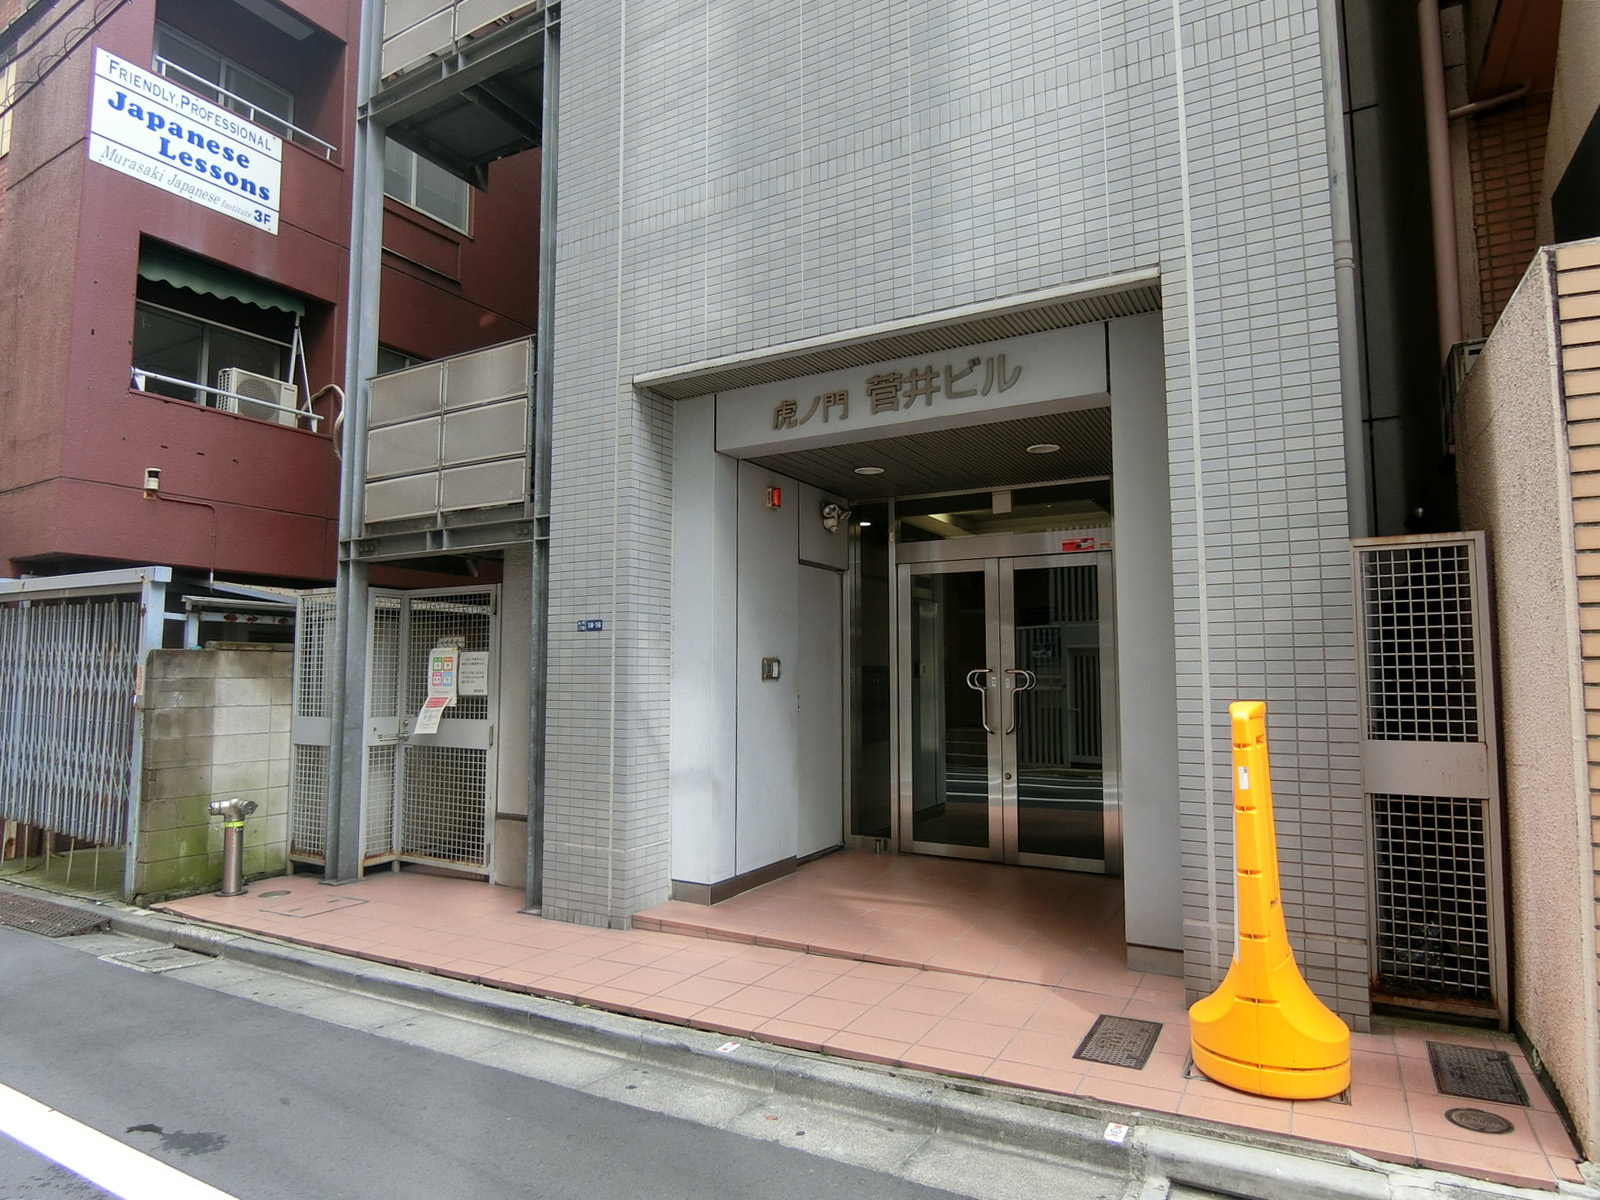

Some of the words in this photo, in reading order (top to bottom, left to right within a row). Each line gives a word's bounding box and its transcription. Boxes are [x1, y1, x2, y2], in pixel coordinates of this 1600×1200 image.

[107, 91, 250, 169] Japanese
[180, 94, 272, 152] PROFESSIONAL
[100, 145, 167, 182] Murasaki
[166, 173, 221, 205] Japanese
[220, 199, 252, 219] Institute
[253, 209, 272, 225] 3F
[158, 136, 271, 201] Lessons
[772, 389, 849, 430] 虎ノ門
[866, 354, 1022, 416] 菅井ビル
